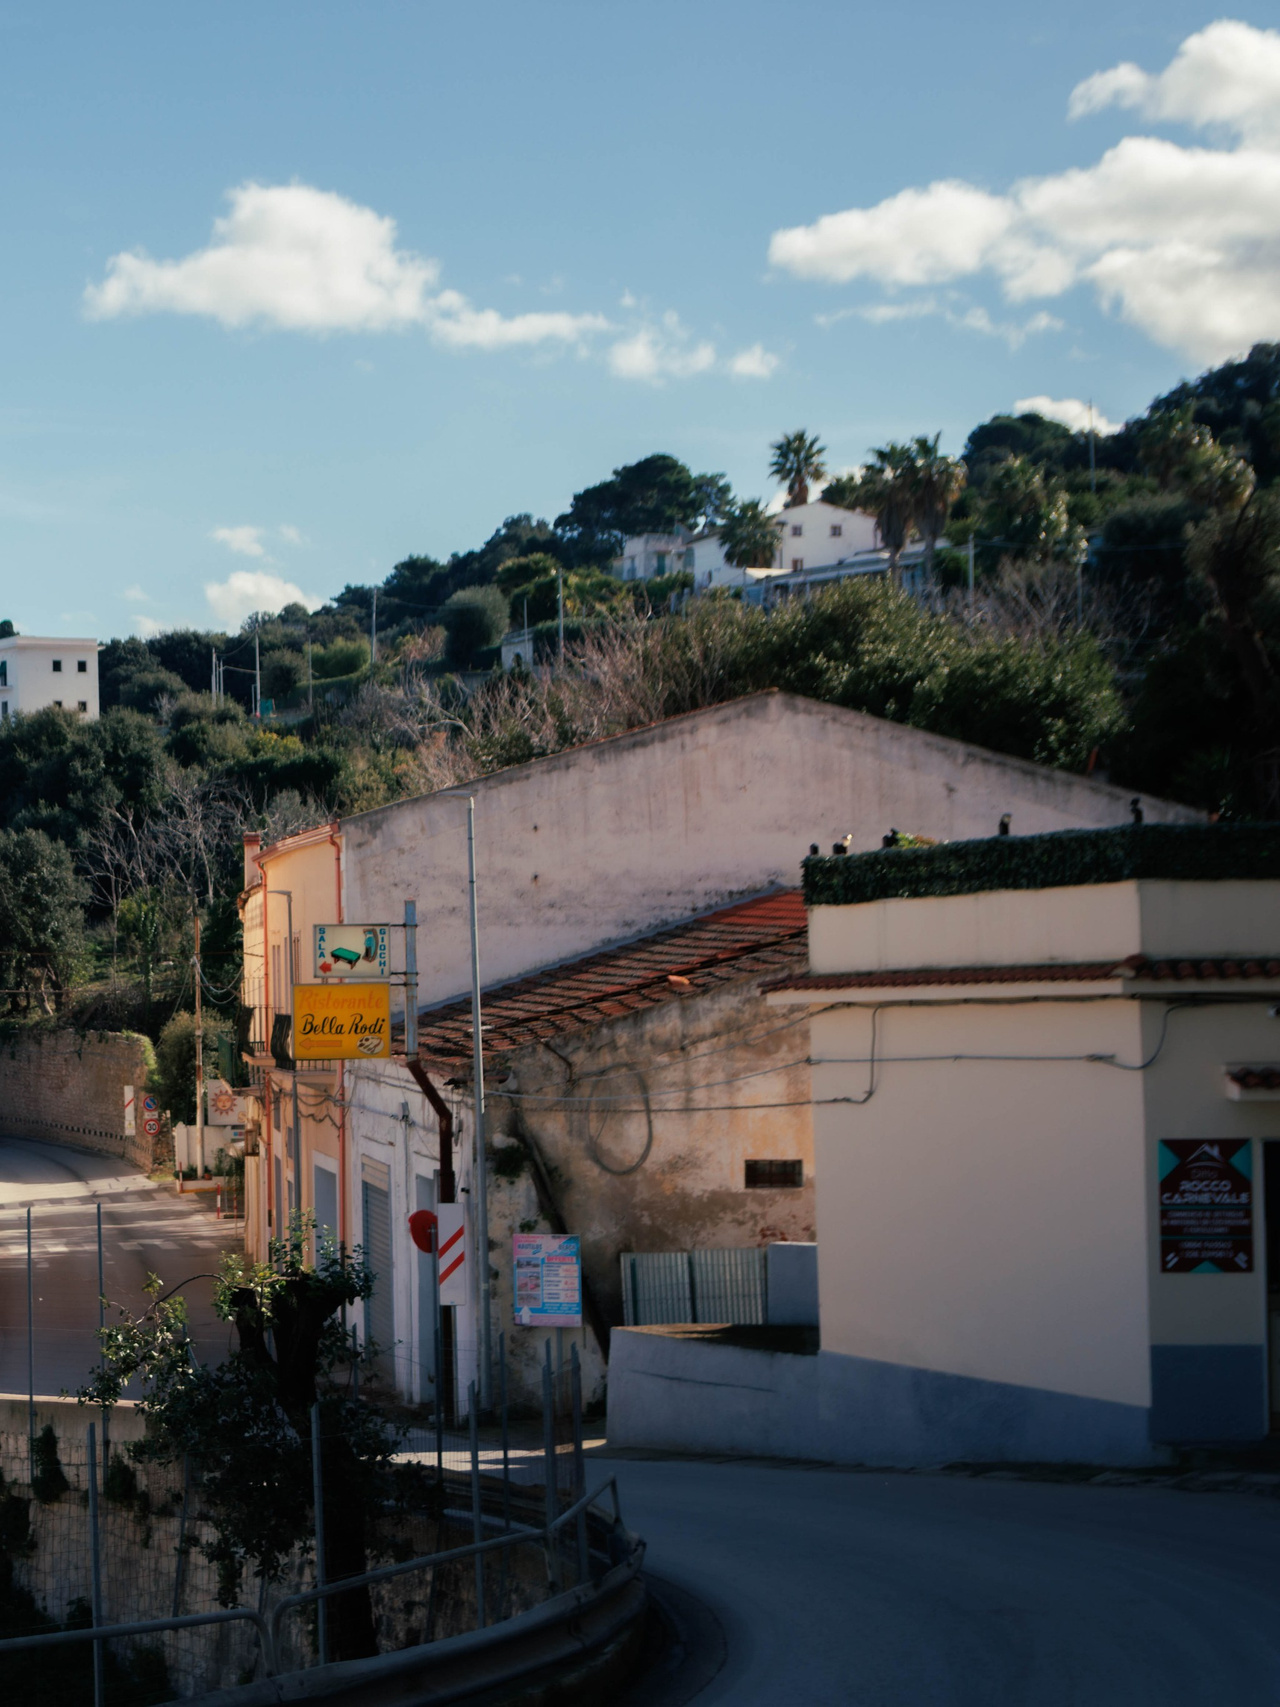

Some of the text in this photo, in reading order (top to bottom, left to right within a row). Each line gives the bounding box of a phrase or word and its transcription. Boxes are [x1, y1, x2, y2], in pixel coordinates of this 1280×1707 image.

[318, 927, 326, 958] SALA
[379, 928, 387, 975] GIOCHI
[298, 989, 384, 1012] Ristorante
[298, 1012, 386, 1035] Bella Rodi
[147, 1123, 157, 1131] 30
[1179, 1180, 1232, 1192] ROCCO
[1161, 1192, 1250, 1204] CARNEVALE
